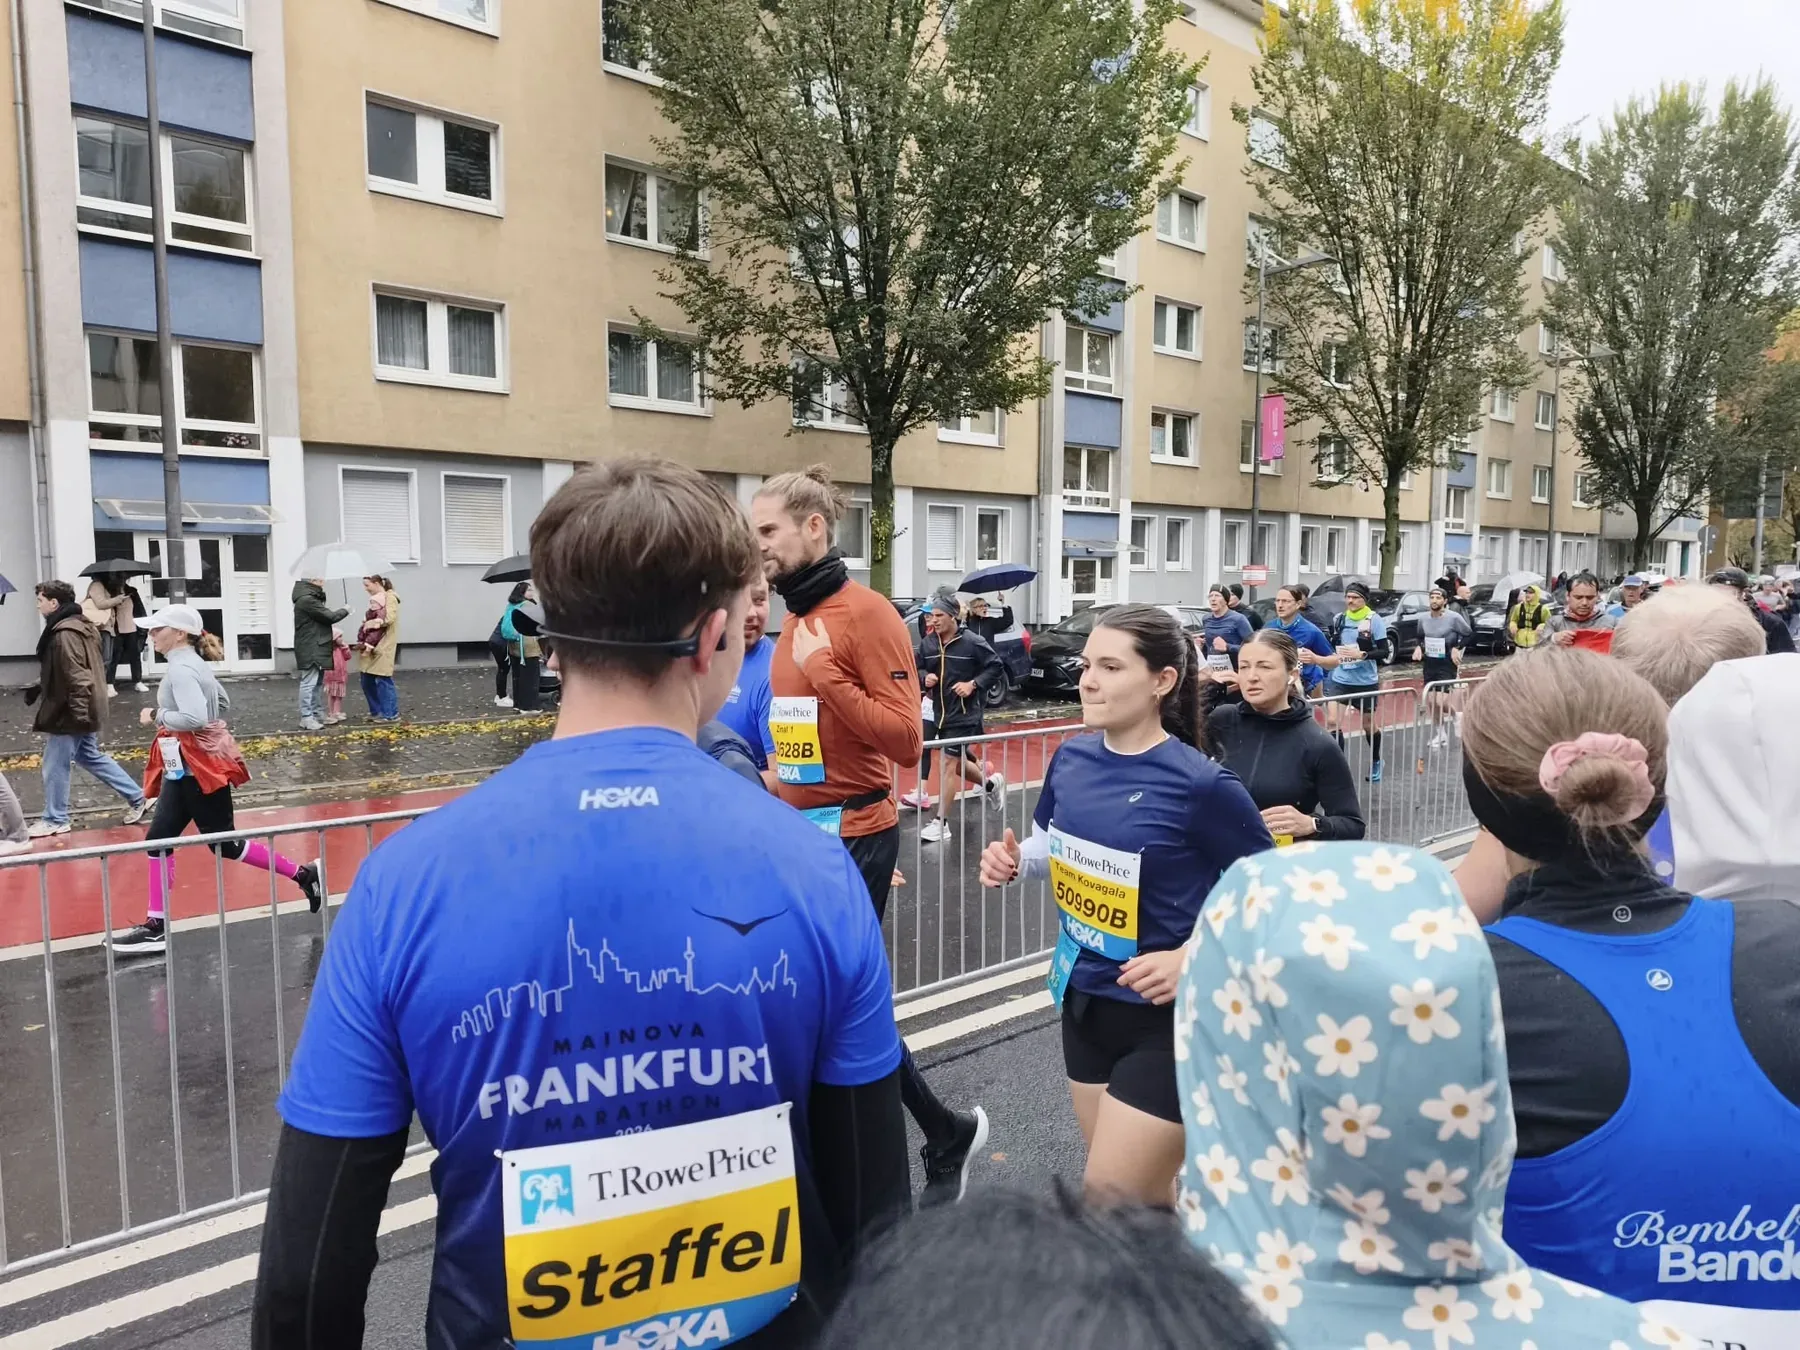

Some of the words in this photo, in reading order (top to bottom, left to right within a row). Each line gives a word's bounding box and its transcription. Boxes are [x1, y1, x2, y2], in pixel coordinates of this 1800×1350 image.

[579, 786, 660, 811] HOKA
[1054, 861, 1076, 880] Team
[1077, 874, 1126, 899] Kovagala
[1056, 880, 1128, 929] 50990B
[1066, 914, 1105, 952] HOKA
[554, 1022, 705, 1055] MAINOVA
[479, 1043, 774, 1120] FRANKFURT
[545, 1096, 721, 1133] MARATHON
[1613, 1204, 1800, 1249] Bembel
[517, 1206, 791, 1319] Staffel
